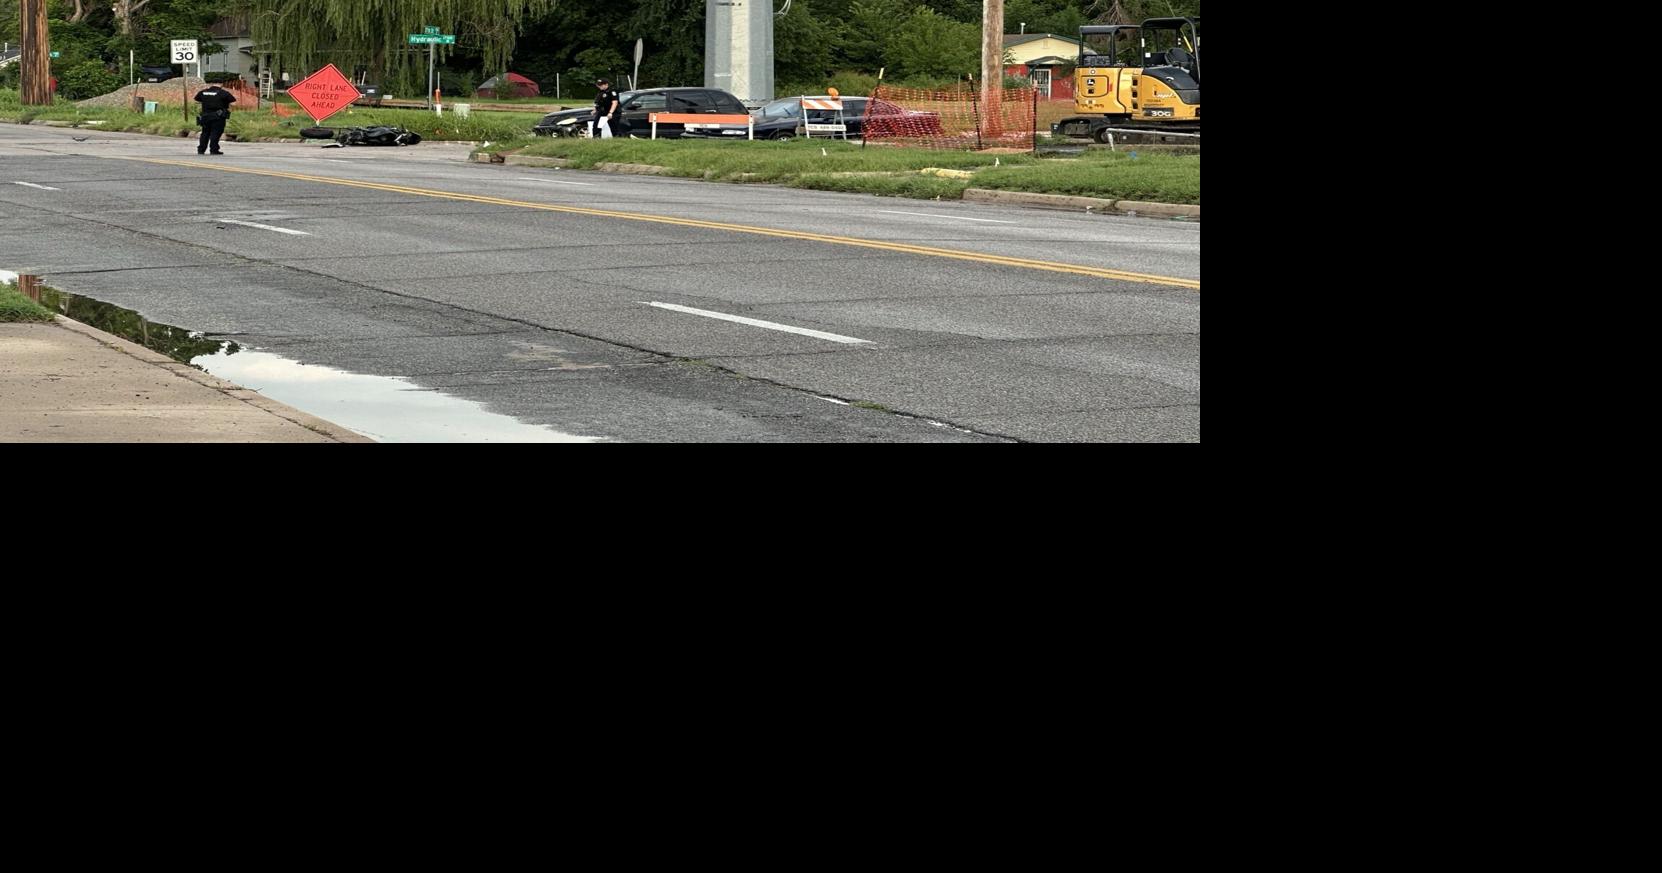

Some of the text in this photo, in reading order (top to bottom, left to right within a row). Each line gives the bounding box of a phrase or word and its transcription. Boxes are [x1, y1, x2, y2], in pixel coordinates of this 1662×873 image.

[410, 36, 442, 44] Hydraulic
[175, 51, 194, 61] 30
[304, 82, 347, 92] RIGHT LANE
[311, 92, 340, 100] CLOSED
[310, 101, 336, 109] AHEAD
